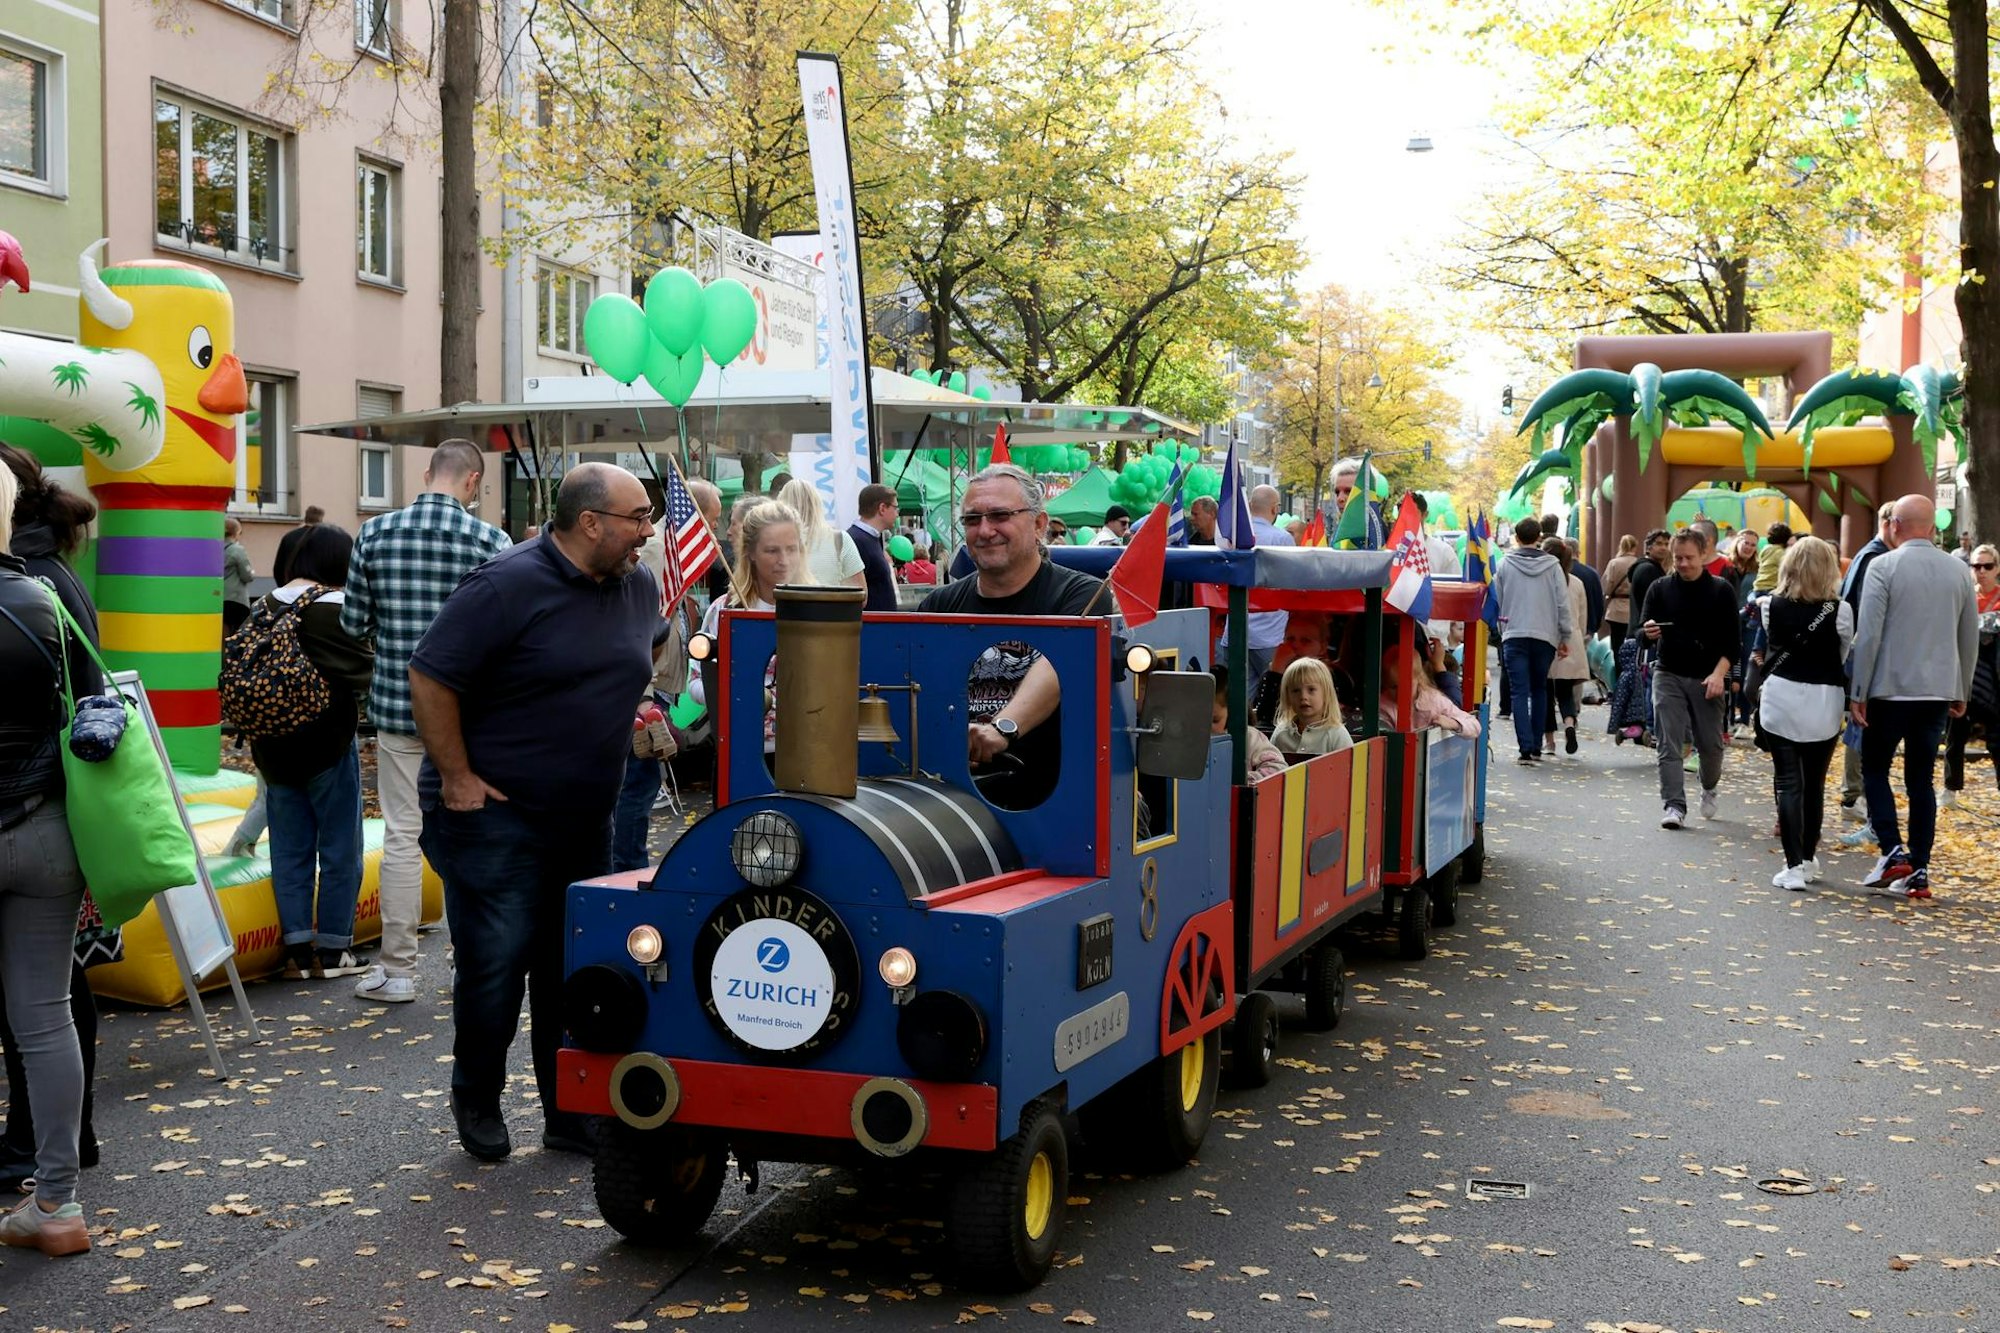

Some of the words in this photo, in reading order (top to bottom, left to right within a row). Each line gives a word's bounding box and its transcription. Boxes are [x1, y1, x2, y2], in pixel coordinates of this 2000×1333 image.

[770, 292, 788, 316] Jahre
[797, 301, 812, 324] Stadt
[771, 321, 783, 340] und
[783, 323, 803, 348] Region
[1140, 856, 1159, 943] 8
[711, 895, 836, 941] KINDER
[726, 978, 817, 1008] ZURICH
[737, 1013, 773, 1026] Manfred
[774, 1018, 803, 1030] Broich
